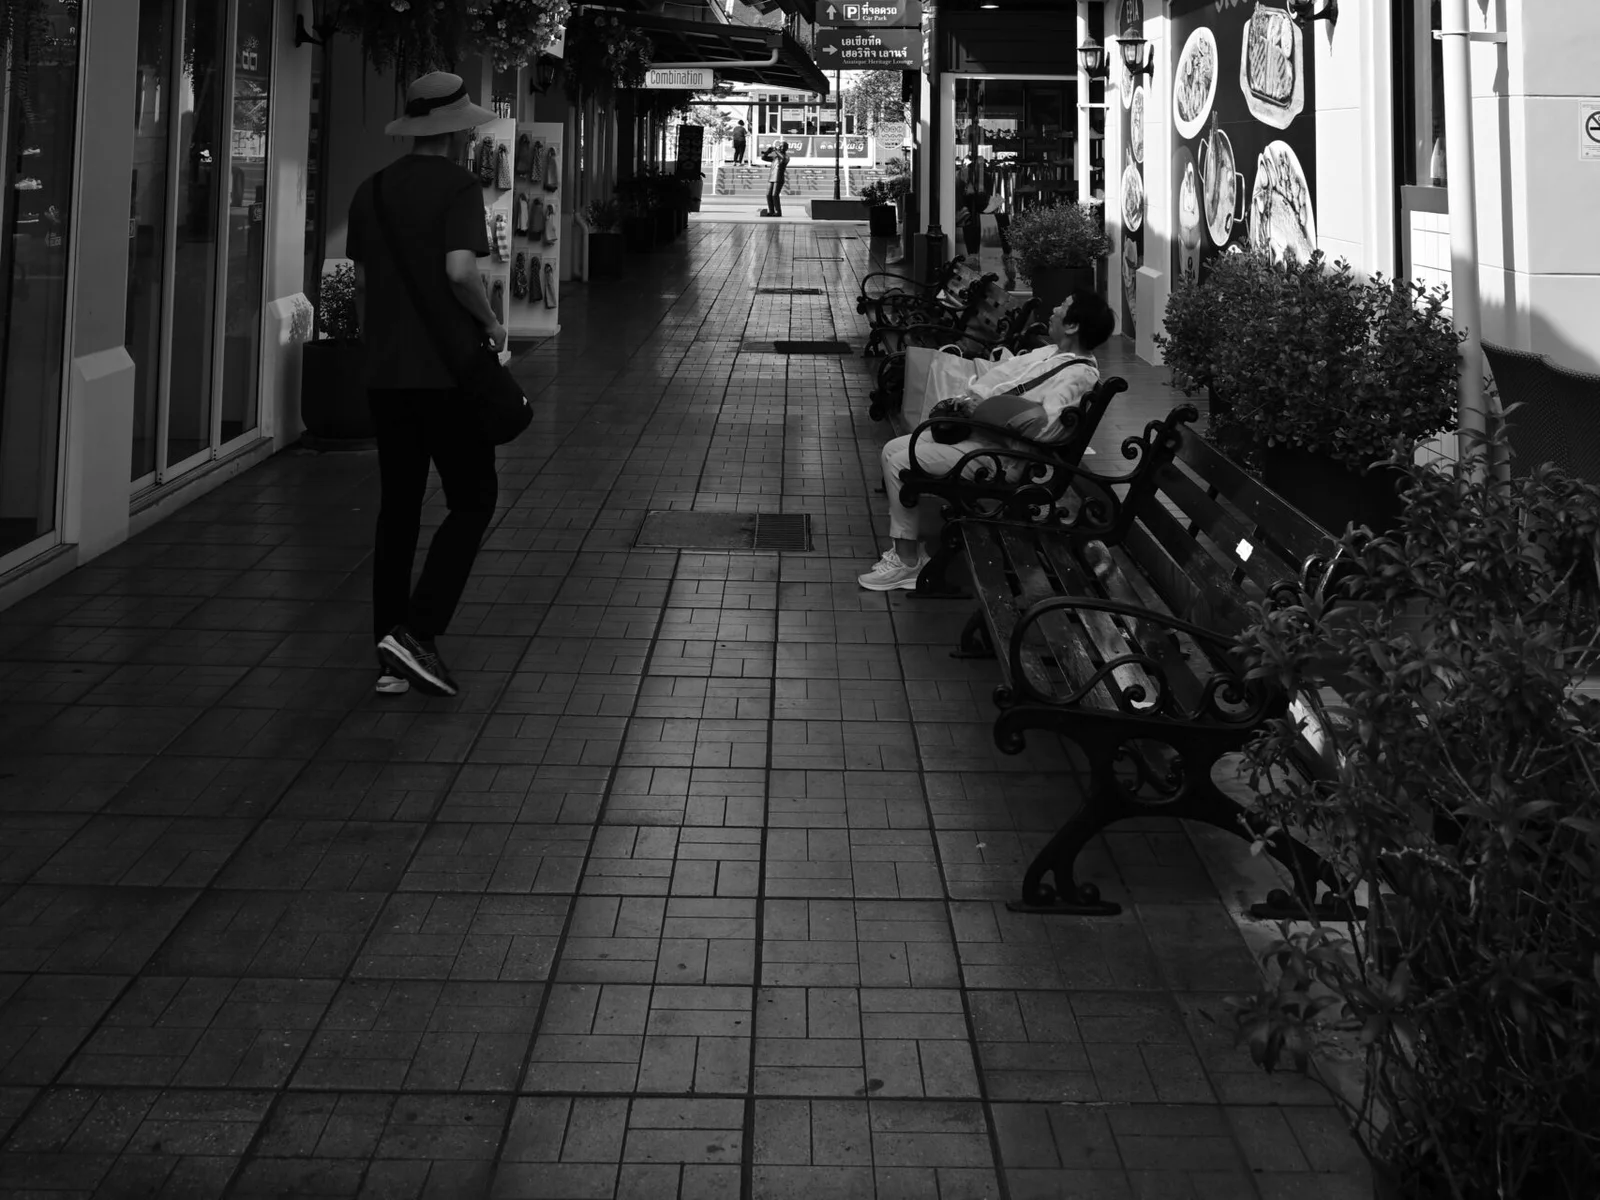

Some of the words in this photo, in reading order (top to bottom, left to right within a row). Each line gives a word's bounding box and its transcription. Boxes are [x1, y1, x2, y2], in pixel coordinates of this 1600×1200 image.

[847, 6, 858, 18] P
[861, 2, 898, 15] ที่จอดรถ
[841, 35, 882, 46] เอเชียทีค
[879, 46, 908, 58] เลานจ์
[650, 70, 703, 85] Combination
[772, 139, 803, 151] Cang
